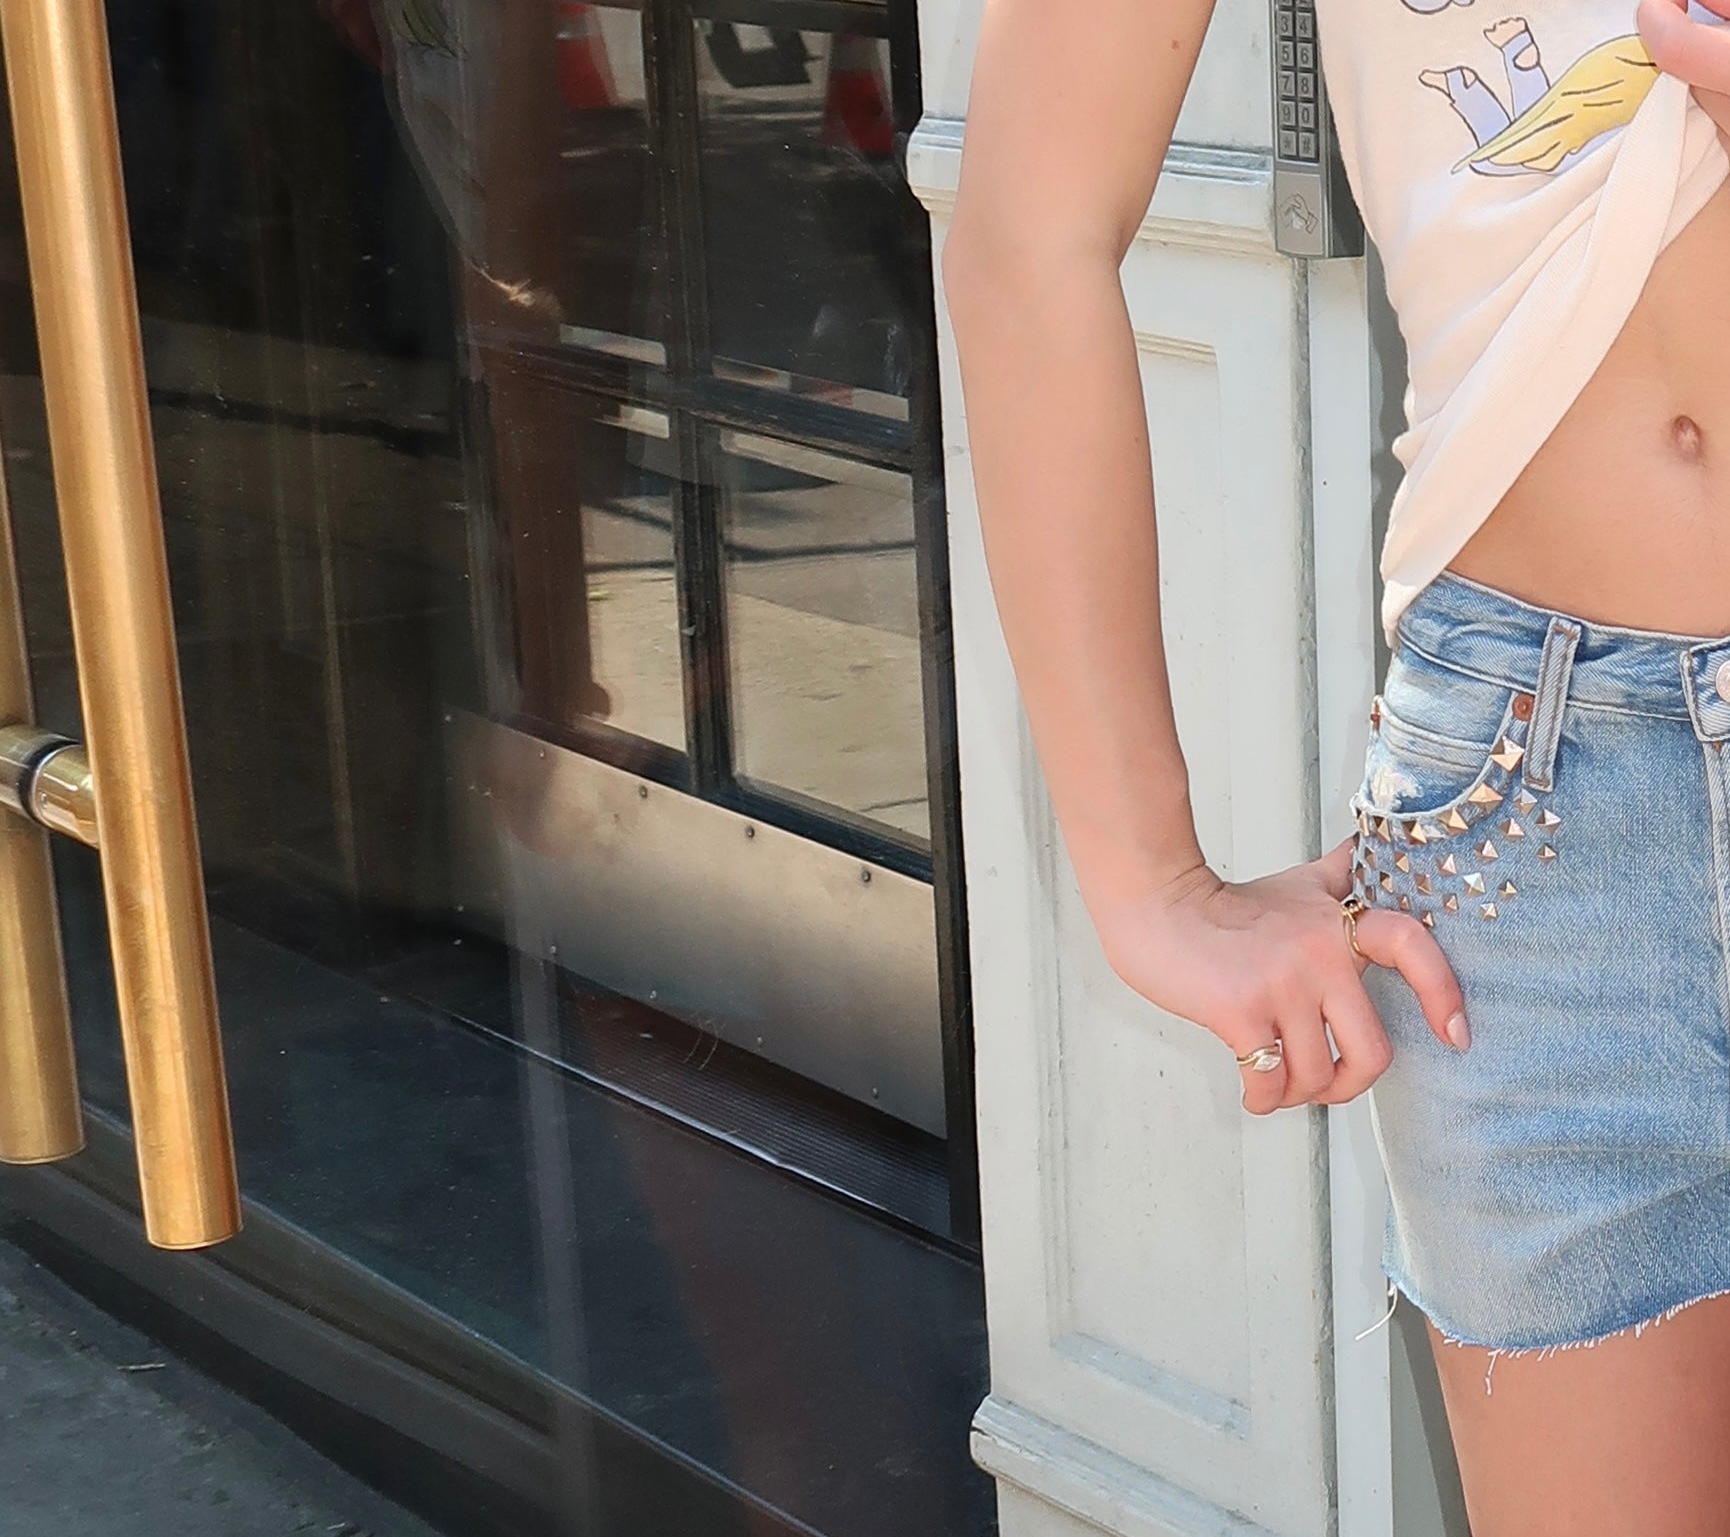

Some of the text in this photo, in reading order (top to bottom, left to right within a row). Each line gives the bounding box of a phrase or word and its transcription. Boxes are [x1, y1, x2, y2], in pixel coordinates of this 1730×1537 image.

[1280, 15, 1308, 35] 3 4
[1281, 45, 1309, 65] 5 6
[1281, 75, 1310, 95] 7 8
[1282, 105, 1291, 122] 9
